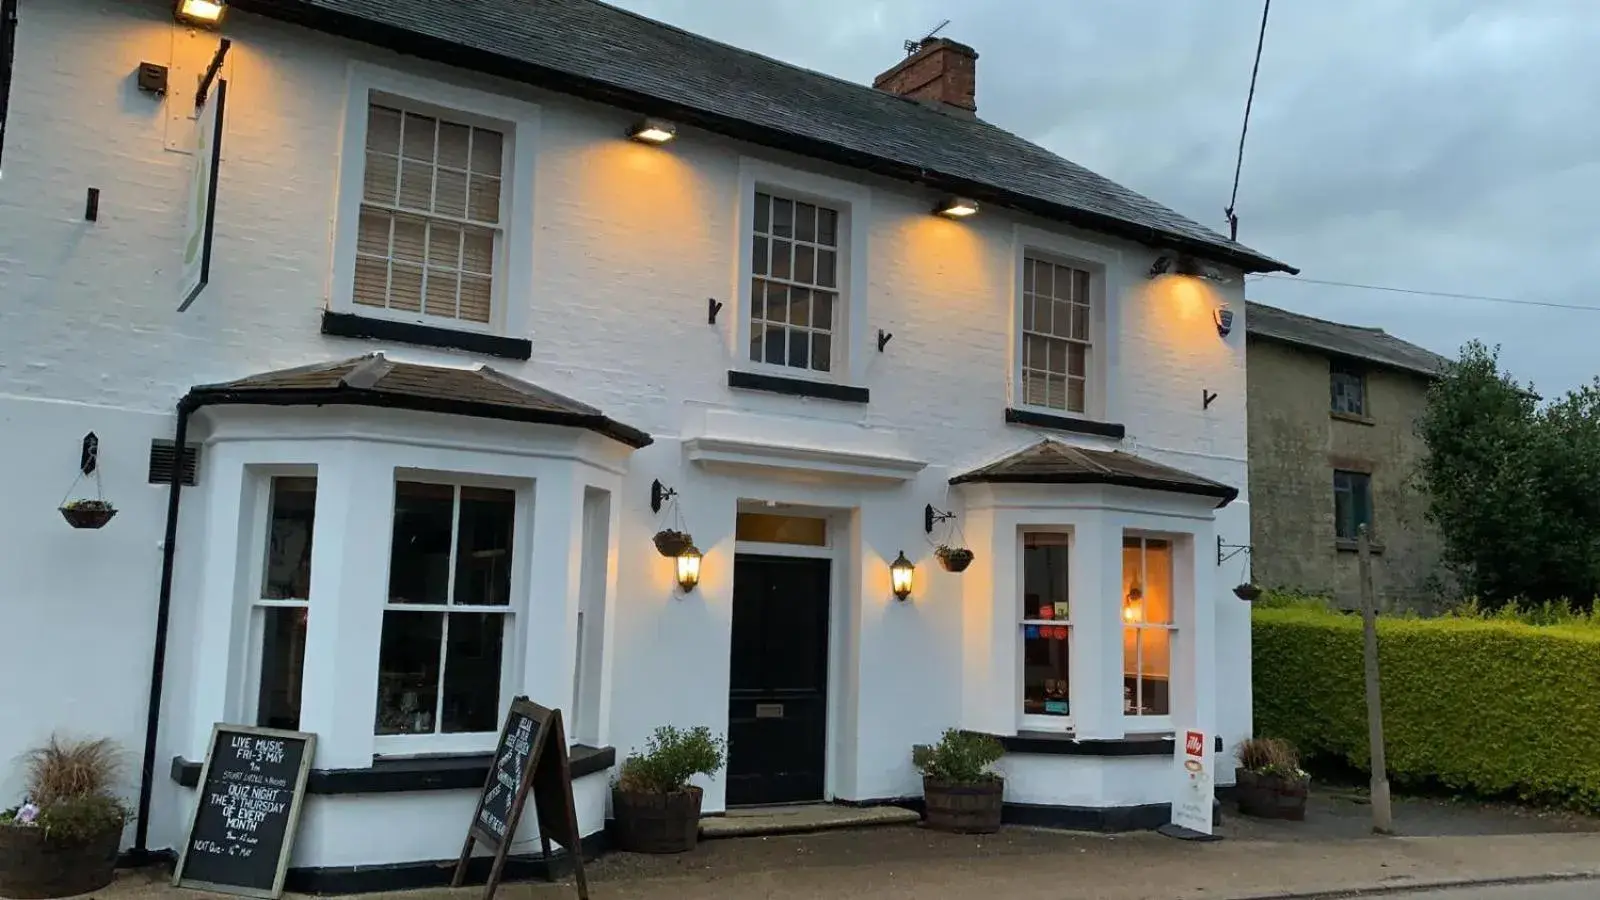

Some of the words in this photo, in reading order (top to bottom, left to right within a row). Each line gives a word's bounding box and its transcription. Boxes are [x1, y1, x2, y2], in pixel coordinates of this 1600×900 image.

[231, 736, 252, 748] LIVE
[255, 739, 284, 752] MUSIC
[1188, 736, 1201, 753] illy
[266, 752, 284, 763] MAY
[228, 784, 250, 797] QUIZ
[251, 786, 279, 801] NIGHT
[211, 793, 228, 806] THE
[240, 798, 286, 813] THURSDAY
[222, 806, 236, 817] OF
[238, 808, 267, 822] EVERY
[226, 818, 257, 831] MONTH
